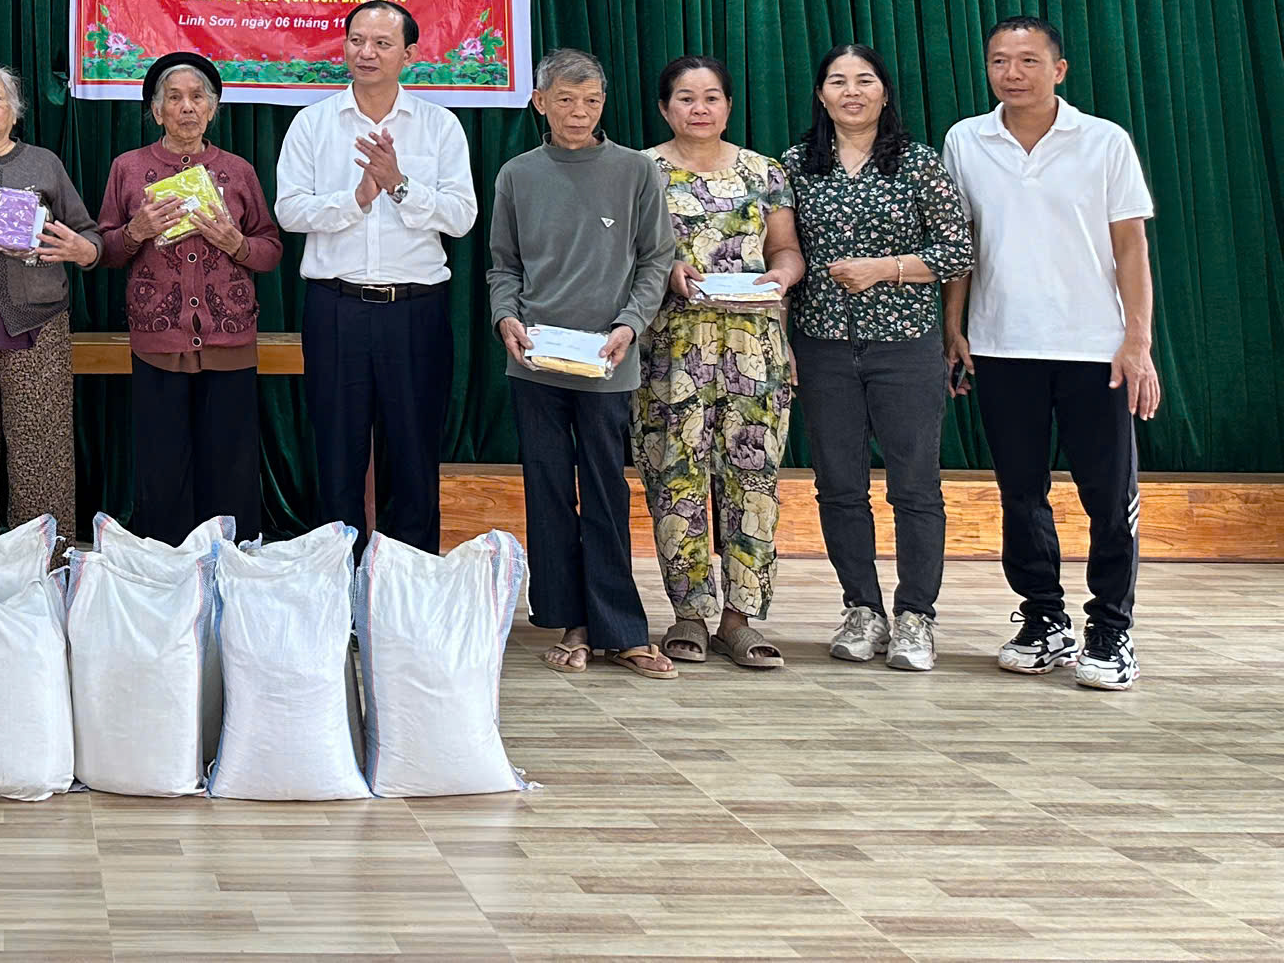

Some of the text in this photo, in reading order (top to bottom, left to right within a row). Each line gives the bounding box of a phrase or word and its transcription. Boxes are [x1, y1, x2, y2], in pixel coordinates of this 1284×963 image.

[178, 14, 346, 30] Linh Sơn, ngày 06 tháng 11
